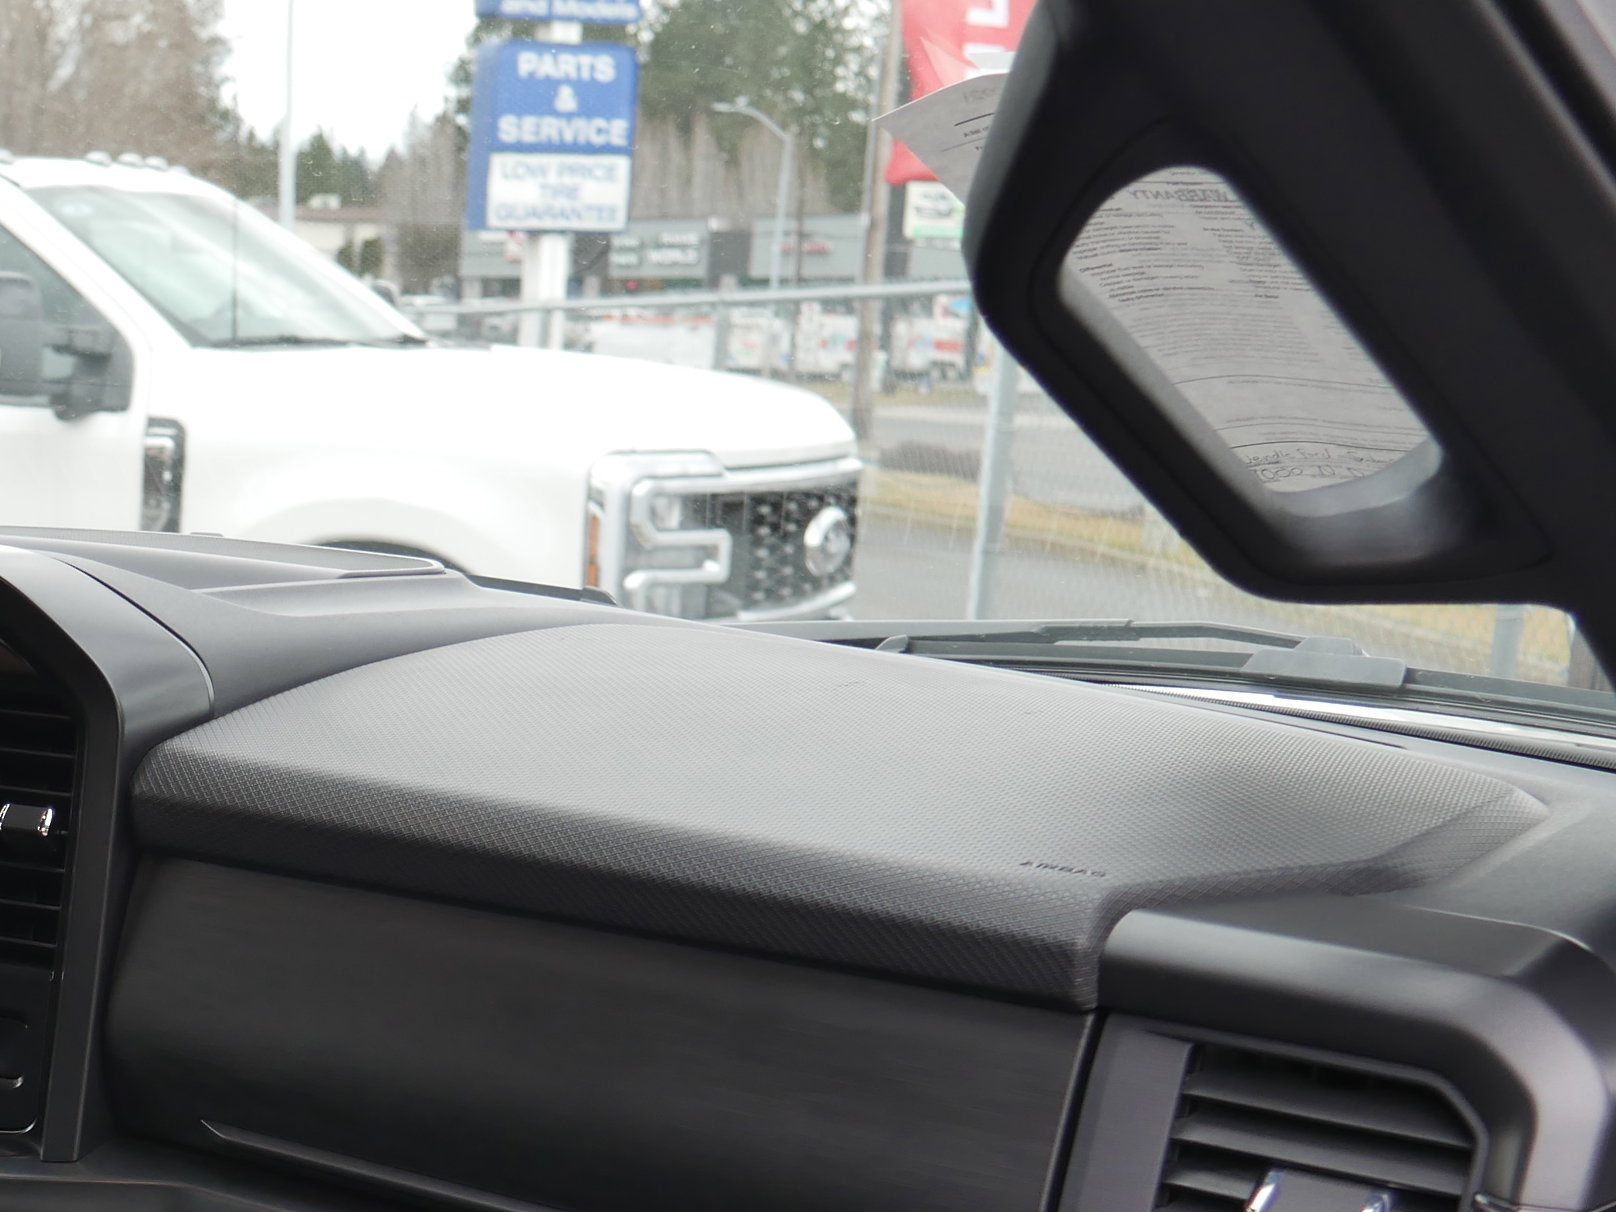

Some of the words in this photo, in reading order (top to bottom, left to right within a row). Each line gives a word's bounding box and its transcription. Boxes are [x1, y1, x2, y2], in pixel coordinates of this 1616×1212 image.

[517, 51, 616, 82] PARTS
[554, 84, 578, 113] &
[497, 114, 629, 147] SERVICE
[501, 161, 549, 180] LOW
[557, 162, 618, 182] PRICE
